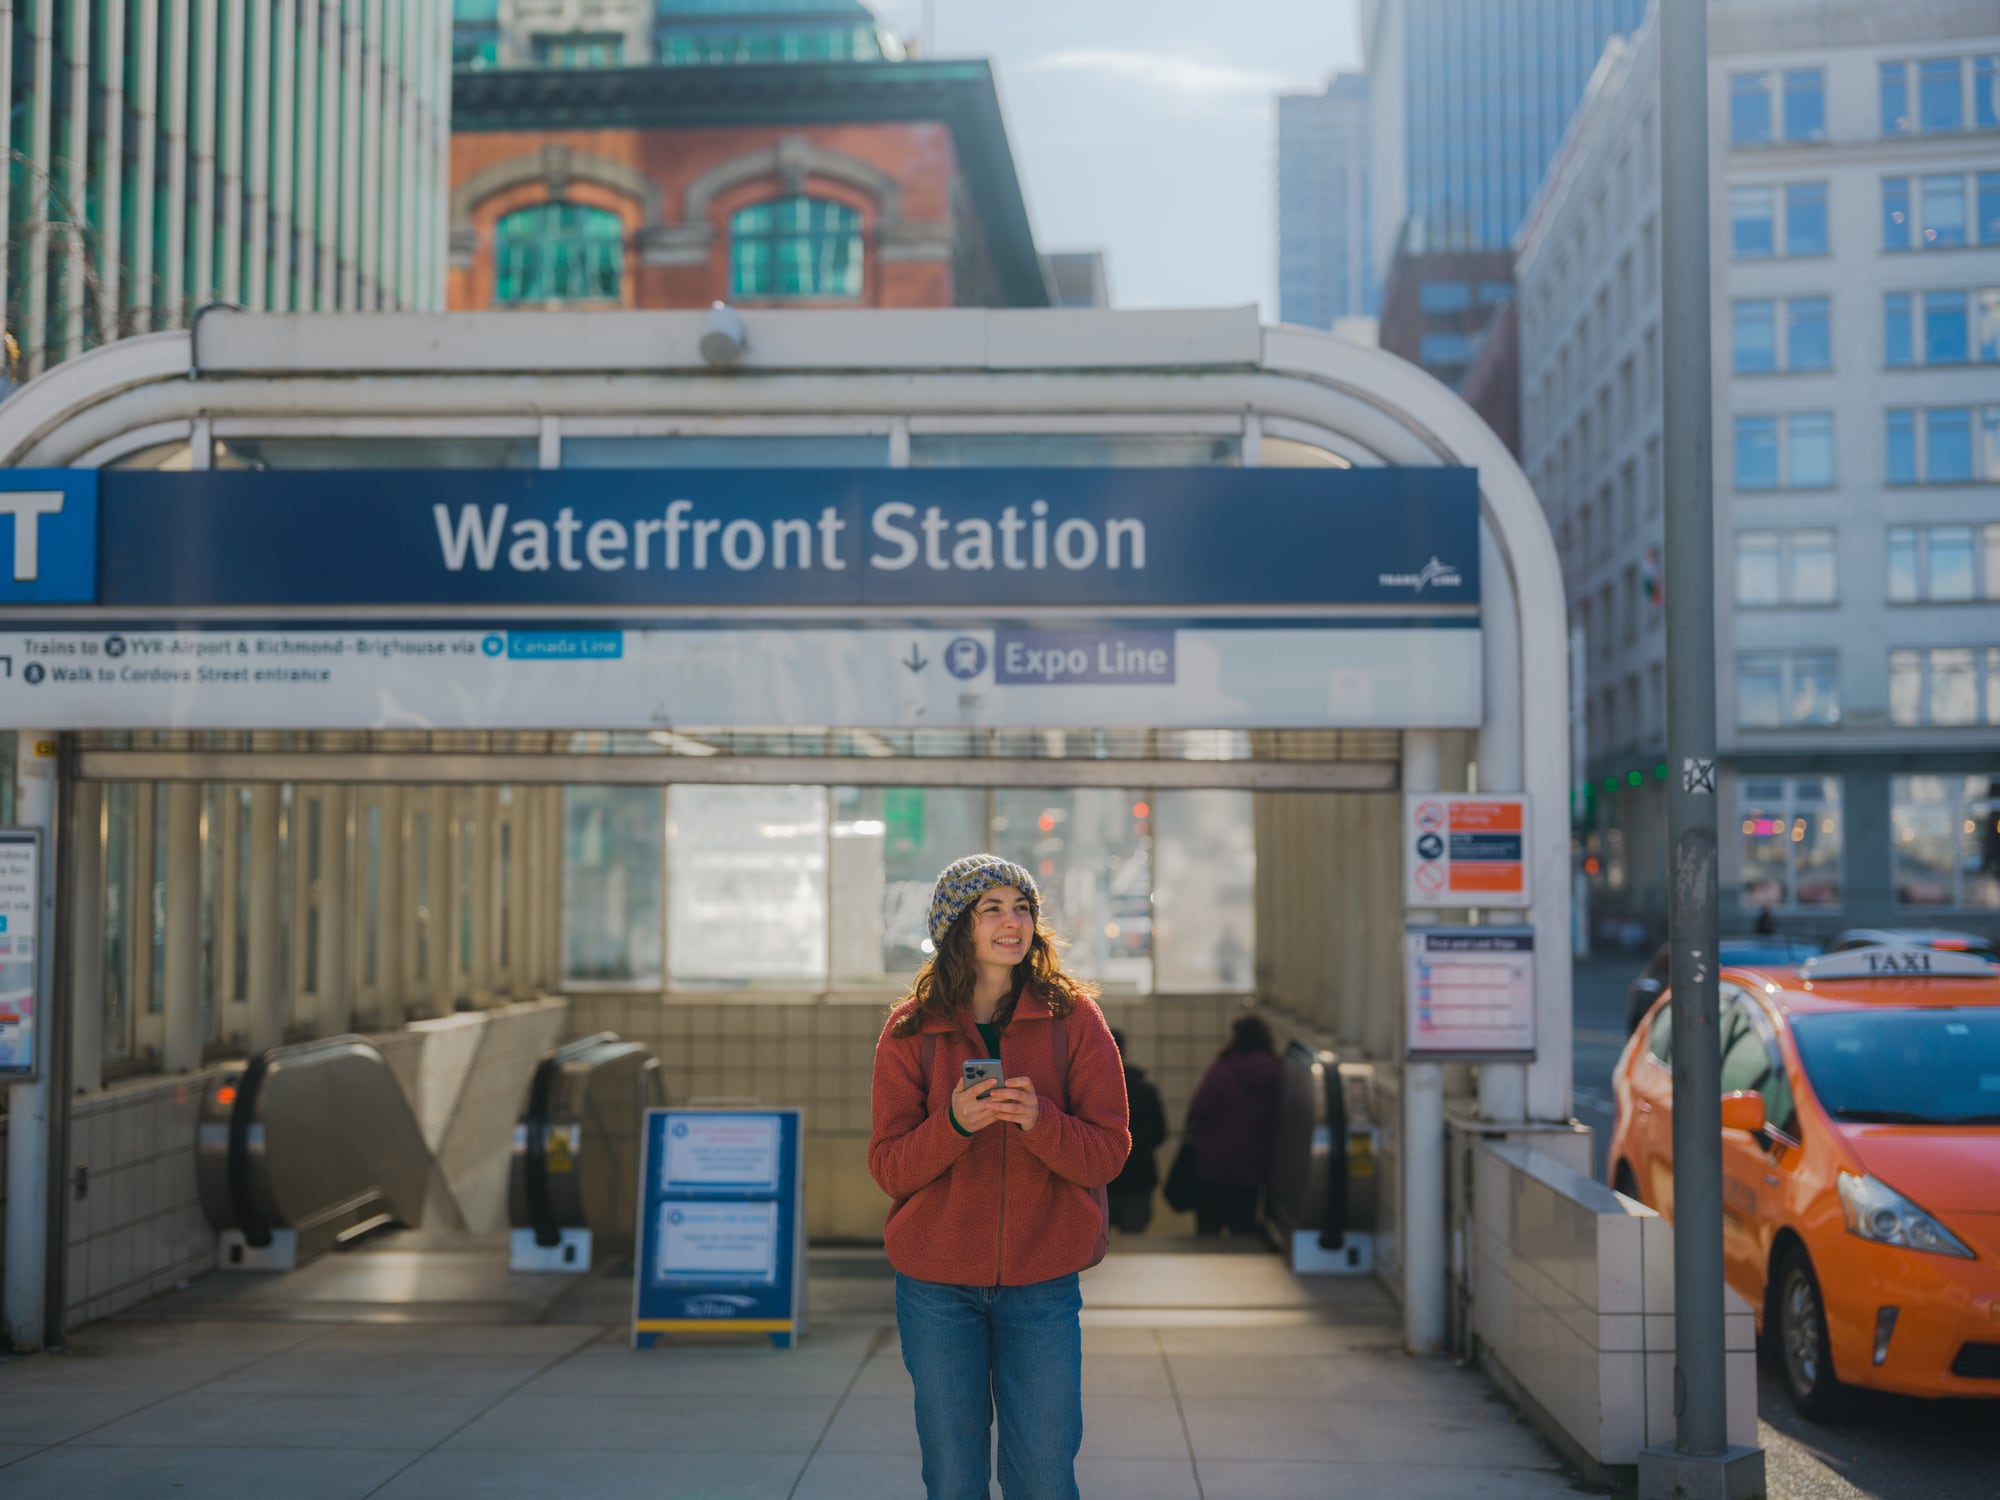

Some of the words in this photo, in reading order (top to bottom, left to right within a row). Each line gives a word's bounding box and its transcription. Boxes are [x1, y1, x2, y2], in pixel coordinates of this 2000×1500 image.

[0, 490, 65, 581] T
[433, 500, 847, 572] Waterfront
[869, 499, 1147, 572] Station
[24, 638, 77, 655] Trains
[81, 639, 98, 655] to
[237, 640, 249, 654] &
[452, 639, 476, 655] via
[513, 638, 577, 654] Canada
[581, 638, 617, 654] Line
[1005, 641, 1088, 681] Expo
[1097, 640, 1168, 675] Line
[51, 666, 93, 682] Walk
[98, 667, 115, 682] to
[120, 666, 191, 682] Cordova
[197, 666, 248, 682] Street
[254, 667, 330, 682] entrance
[1864, 952, 1932, 972] TAXI
